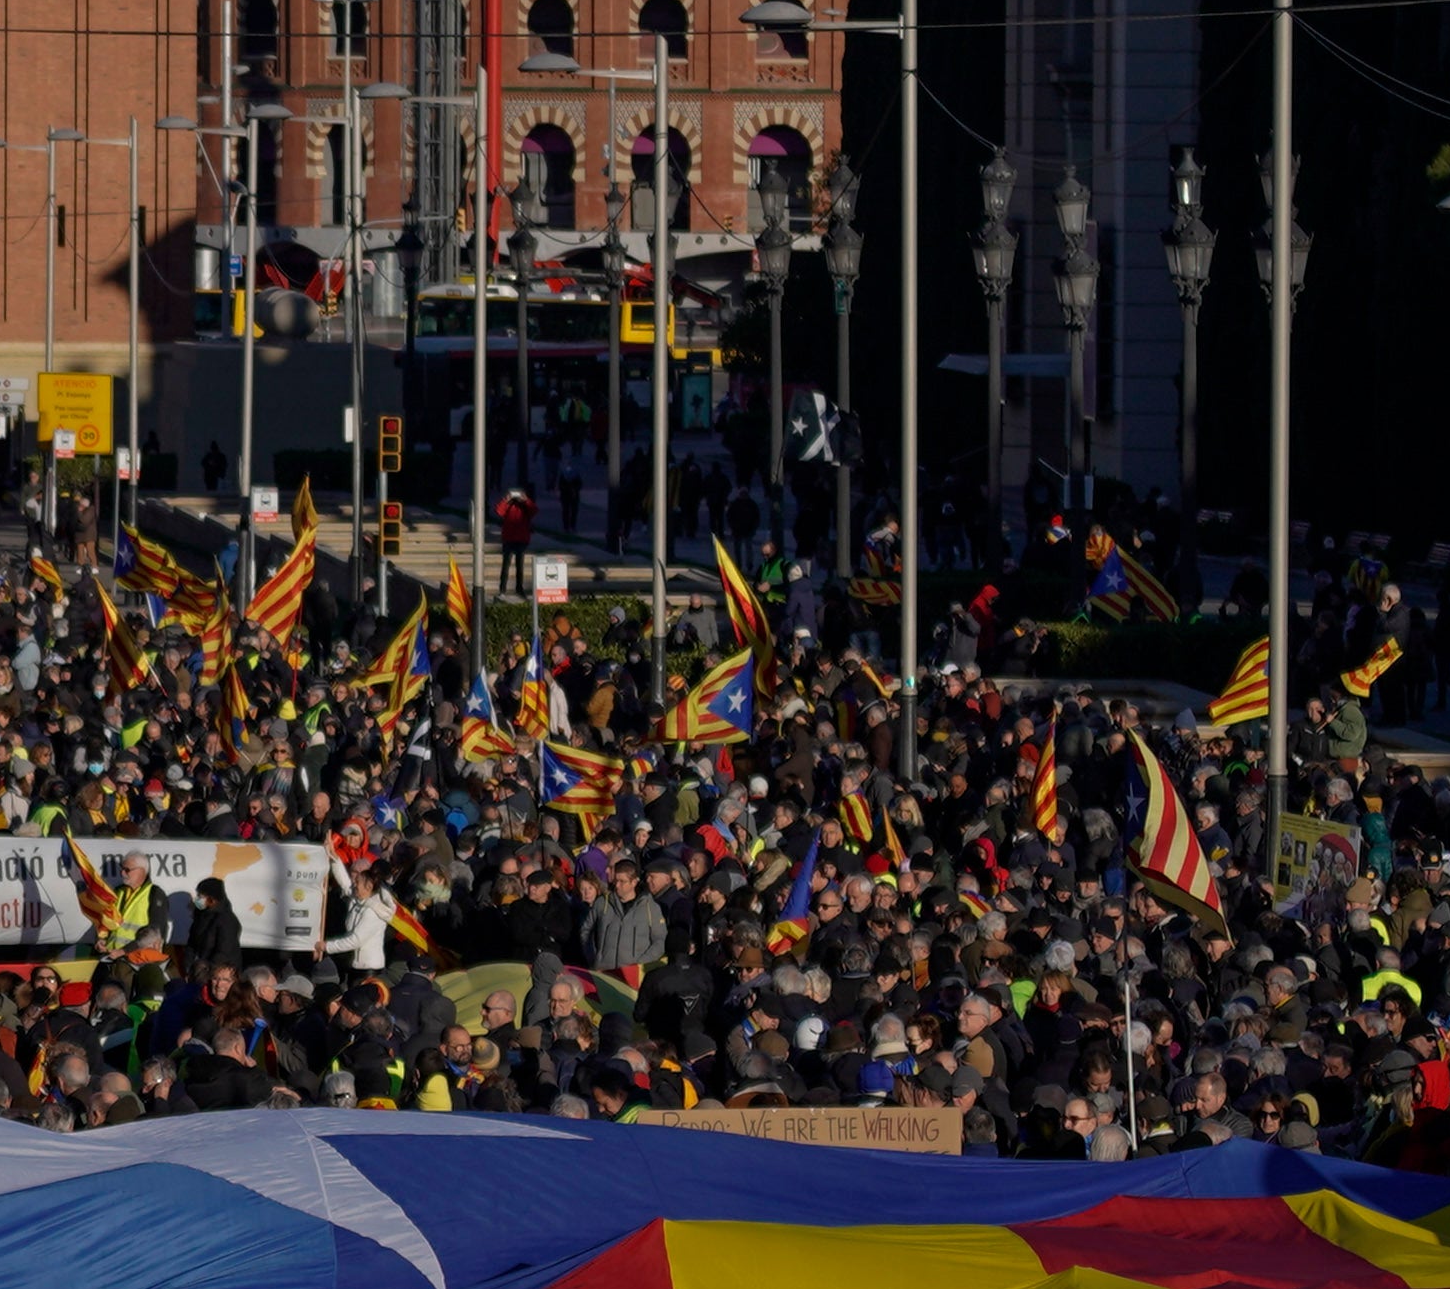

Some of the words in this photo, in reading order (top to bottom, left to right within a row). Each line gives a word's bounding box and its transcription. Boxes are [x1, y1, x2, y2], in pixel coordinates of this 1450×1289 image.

[83, 432, 96, 440] 30
[296, 869, 319, 880] punt
[740, 1111, 773, 1140] WE
[784, 1117, 819, 1142] ARE
[824, 1113, 858, 1142] THE
[862, 1112, 940, 1143] WALKING
